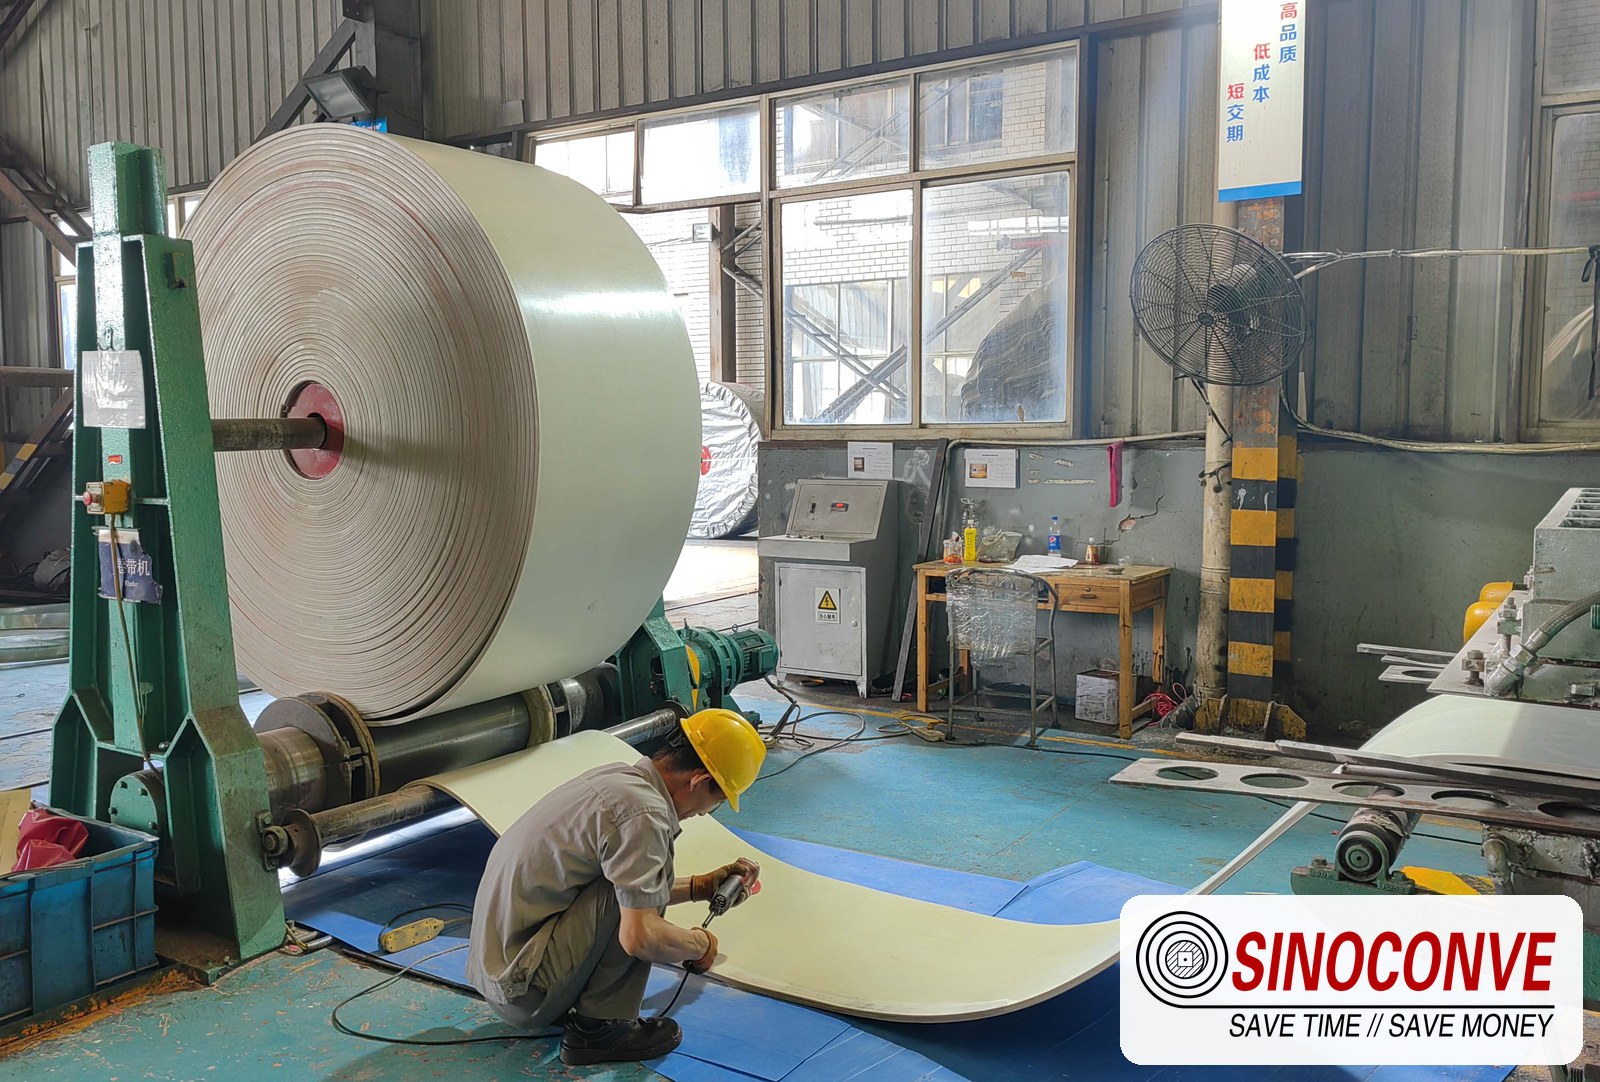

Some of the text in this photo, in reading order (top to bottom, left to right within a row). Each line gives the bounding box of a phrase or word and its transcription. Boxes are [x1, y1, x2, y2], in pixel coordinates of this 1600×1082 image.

[1279, 1, 1298, 64] 高品质
[1252, 42, 1271, 103] 低成本
[1226, 82, 1245, 143] 短交期
